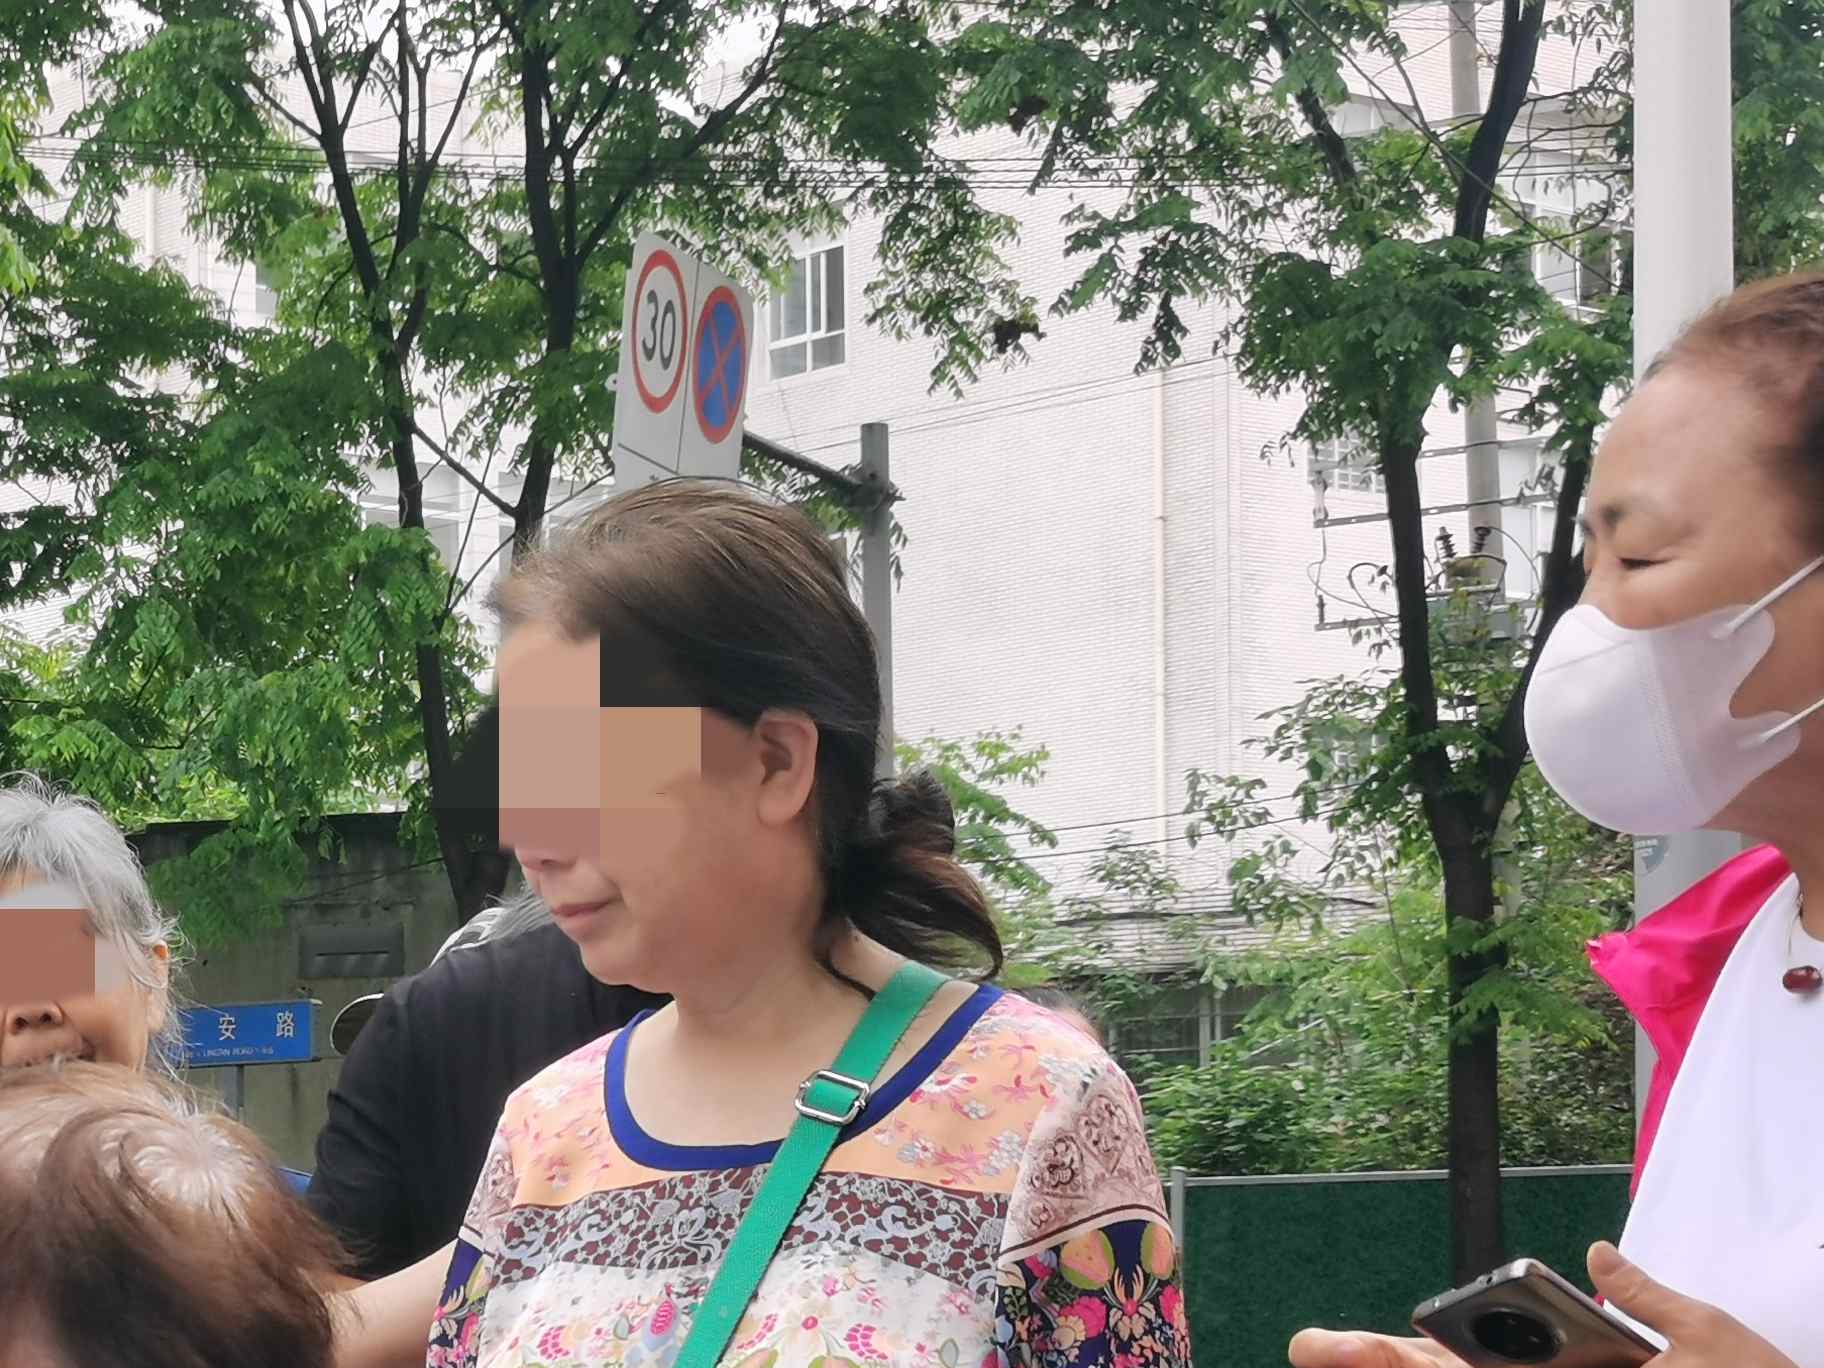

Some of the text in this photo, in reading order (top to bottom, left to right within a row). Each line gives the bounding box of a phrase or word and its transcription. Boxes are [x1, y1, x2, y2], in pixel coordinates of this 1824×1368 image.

[642, 289, 676, 371] 30
[218, 1010, 295, 1041] 安 路
